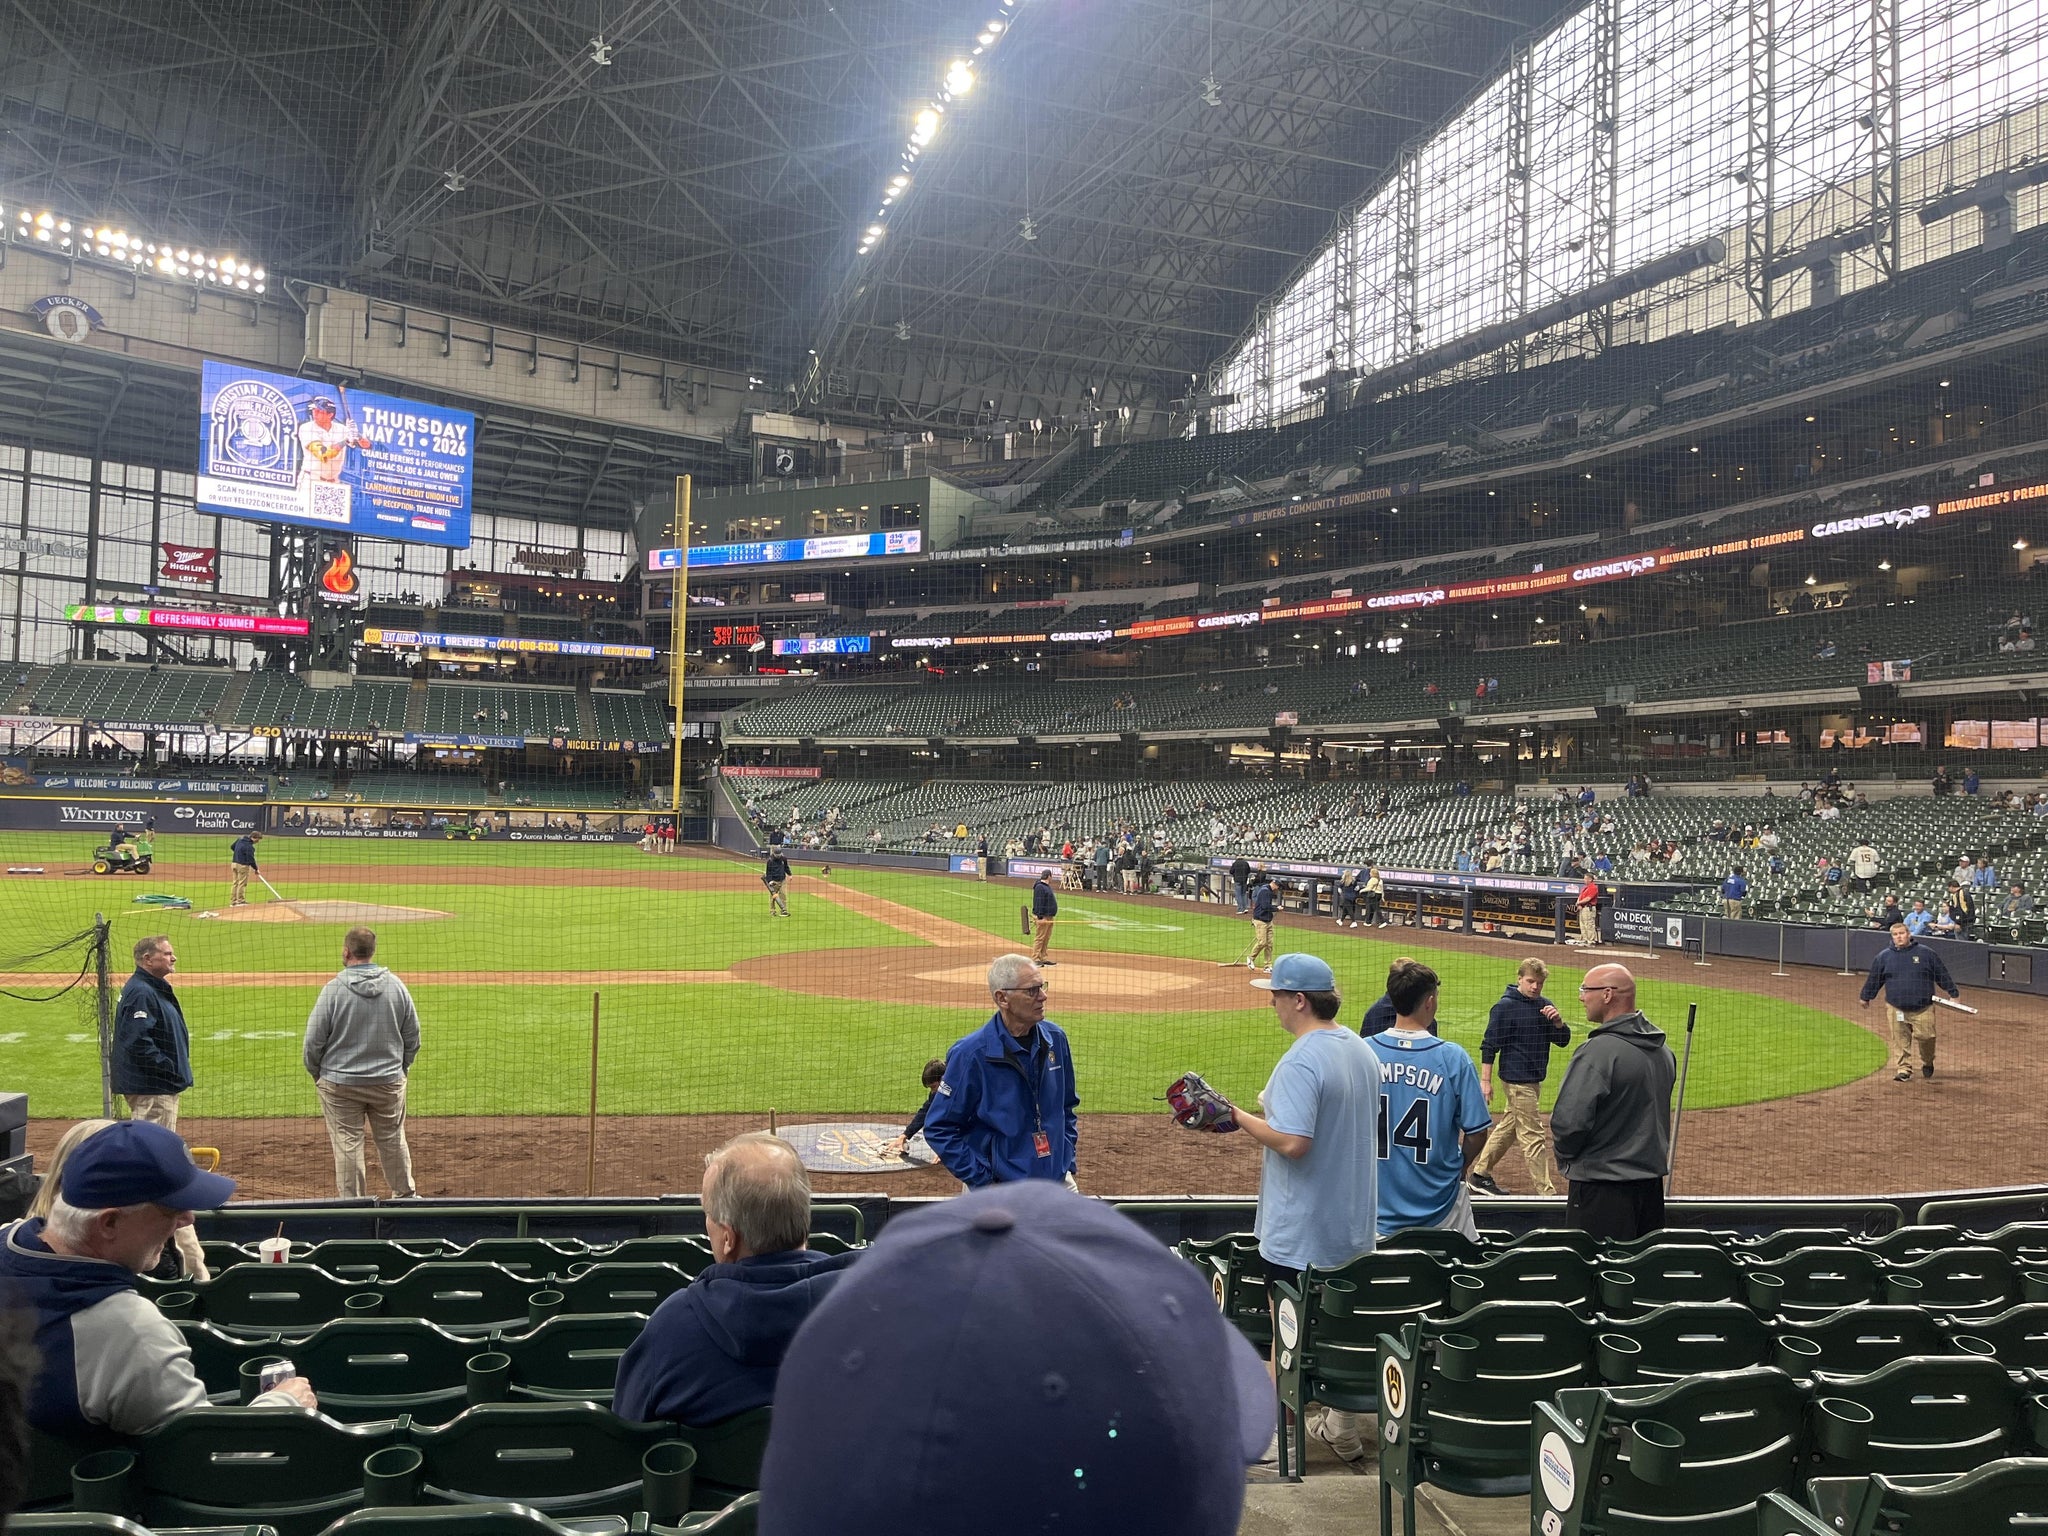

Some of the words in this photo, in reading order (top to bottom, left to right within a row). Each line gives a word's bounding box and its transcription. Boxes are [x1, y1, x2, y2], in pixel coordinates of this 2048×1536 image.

[47, 296, 89, 313] UECKER
[216, 384, 258, 415] CHRISTIAN
[262, 388, 293, 425] YELICH'S
[362, 406, 467, 440] THURSDAY
[362, 423, 394, 443] MAY
[397, 429, 415, 448] 21
[432, 436, 466, 457] 2026
[361, 449, 389, 461] CHARLIE
[389, 453, 415, 465] BERENS
[415, 458, 421, 466] &
[421, 459, 465, 473] PERFORMANCES
[213, 464, 252, 476] CHARITY
[253, 469, 292, 483] CONCERT
[367, 459, 376, 467] BY
[376, 461, 396, 471] ISAAC
[396, 465, 417, 475] SLADE
[417, 468, 423, 476] &
[423, 469, 439, 479] JAKE
[217, 484, 237, 493] SCAN
[365, 482, 401, 495] LANDMARK
[402, 487, 424, 498] CREDIT
[425, 491, 445, 502] UNION
[446, 495, 460, 504] LIVE
[416, 504, 434, 514] TRADE
[1252, 507, 1287, 522] BREWERS
[1289, 497, 1336, 516] COMMUNITY
[1339, 487, 1392, 506] FOUNDATION
[1937, 491, 2010, 515] MILWAUKEE'S
[1811, 504, 1931, 537] CARNEVOR
[51, 540, 90, 559] Care
[1659, 547, 1710, 565] MILWAUKEE'S
[1712, 539, 1748, 555] PREMIER
[1750, 529, 1804, 549] STEAKHOUSE
[173, 550, 205, 564] Miller
[512, 545, 586, 569] Johnsonville
[169, 563, 190, 571] HIGH
[1572, 556, 1656, 580] CARNEVOR
[1449, 584, 1496, 598] MILWAUKEE'S
[1497, 580, 1529, 592] PREMIER
[1530, 573, 1568, 589] STEAKHOUSE
[1367, 589, 1445, 608] CARNEVOR
[1262, 607, 1299, 620] MILWAUKEE'S
[1299, 604, 1325, 616] PREMIER
[1326, 600, 1362, 612] STEAKHOUSE
[154, 612, 217, 627] REFRESHINGLY
[218, 617, 255, 629] SUMMER
[1197, 611, 1260, 628] CARNEVOR
[382, 631, 396, 641] TEXT
[395, 633, 417, 643] ALERTS
[421, 635, 441, 645] TEXT
[497, 639, 518, 651] (414)
[891, 637, 951, 649] CARNEVOR
[1050, 629, 1113, 643] CARNEVOR
[807, 640, 837, 652] 5:48
[128, 723, 153, 731] TASTE.
[166, 725, 203, 733] CALORIES.
[253, 726, 281, 738] 620
[282, 728, 327, 740] WTMJ
[468, 735, 520, 747] WINTRUST
[566, 739, 601, 751] NICOLET
[602, 741, 620, 752] LAW
[74, 778, 107, 789] WELCOME
[119, 780, 153, 790] DELICIOUS
[187, 781, 220, 792] WELCOME
[230, 783, 264, 793] DELICIOUS
[60, 806, 145, 821] WINTRUST
[196, 809, 231, 819] Aurora
[658, 817, 671, 825] 345
[195, 819, 229, 829] Health
[231, 819, 255, 829] Care
[341, 829, 363, 837] Health
[382, 830, 419, 838] BULLPEN
[543, 833, 563, 841] Health
[1861, 853, 1871, 862] 15
[1481, 893, 1510, 907] SARGENTO
[1613, 911, 1628, 922] ON
[1629, 912, 1652, 924] DECK
[1613, 923, 1638, 931] BREWERS
[1380, 1063, 1444, 1095] MPSON
[1378, 1094, 1432, 1165] 14
[1546, 1518, 1555, 1533] 5
